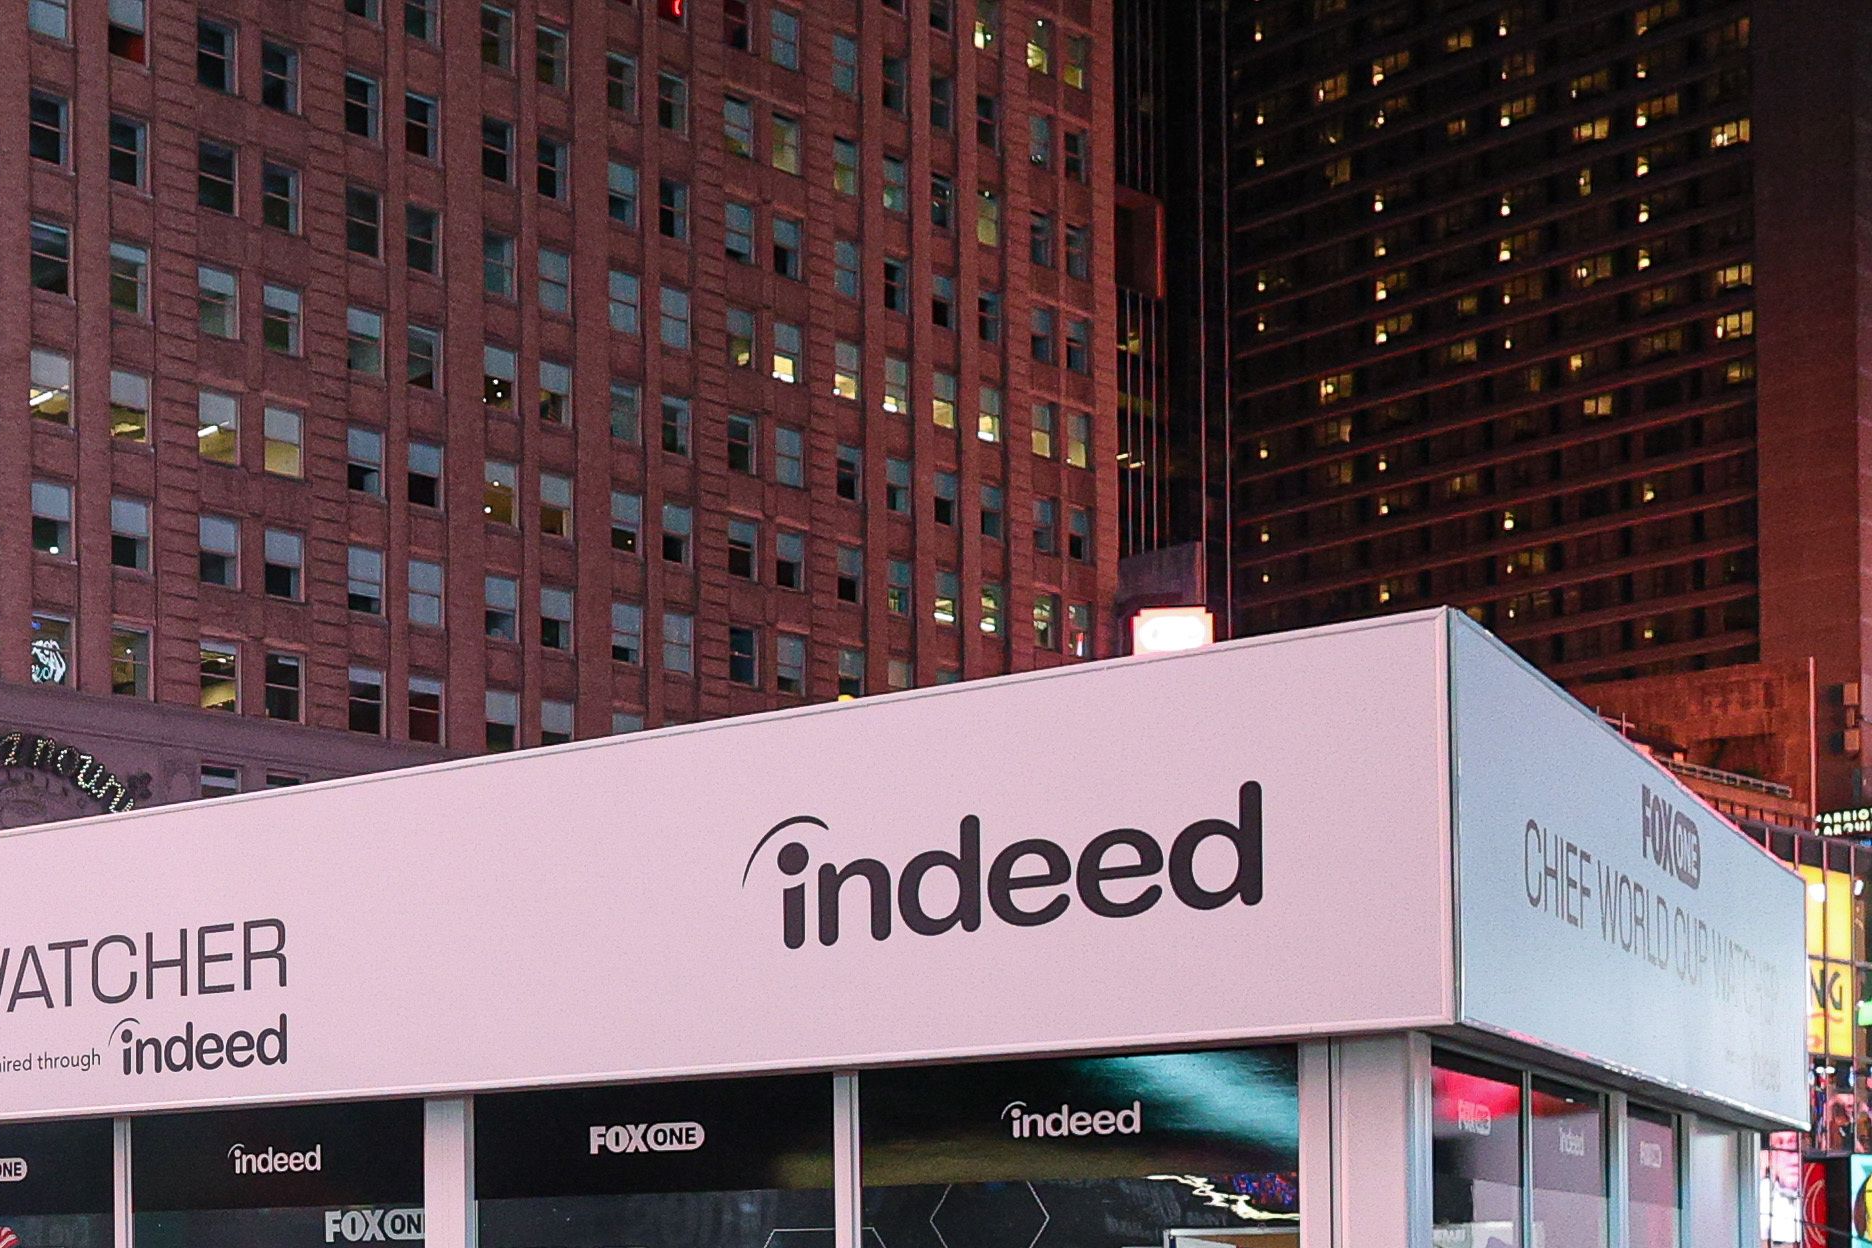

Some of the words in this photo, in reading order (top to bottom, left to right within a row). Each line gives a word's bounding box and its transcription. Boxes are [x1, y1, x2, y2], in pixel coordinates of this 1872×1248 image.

[1641, 783, 1673, 877] FOX
[1815, 808, 1872, 824] ARRIO
[746, 779, 1263, 950] indeed
[1524, 818, 1592, 930] CHIEF
[1597, 859, 1670, 971] WORLD
[1673, 906, 1707, 986] CUP
[37, 1048, 102, 1072] through
[111, 1013, 288, 1076] indeed
[589, 1123, 649, 1155] FOX
[652, 1125, 699, 1147] ONE
[1002, 1100, 1142, 1139] indeed
[229, 1143, 322, 1175] indeed
[324, 1209, 385, 1243] FOX
[388, 1212, 425, 1236] ON
